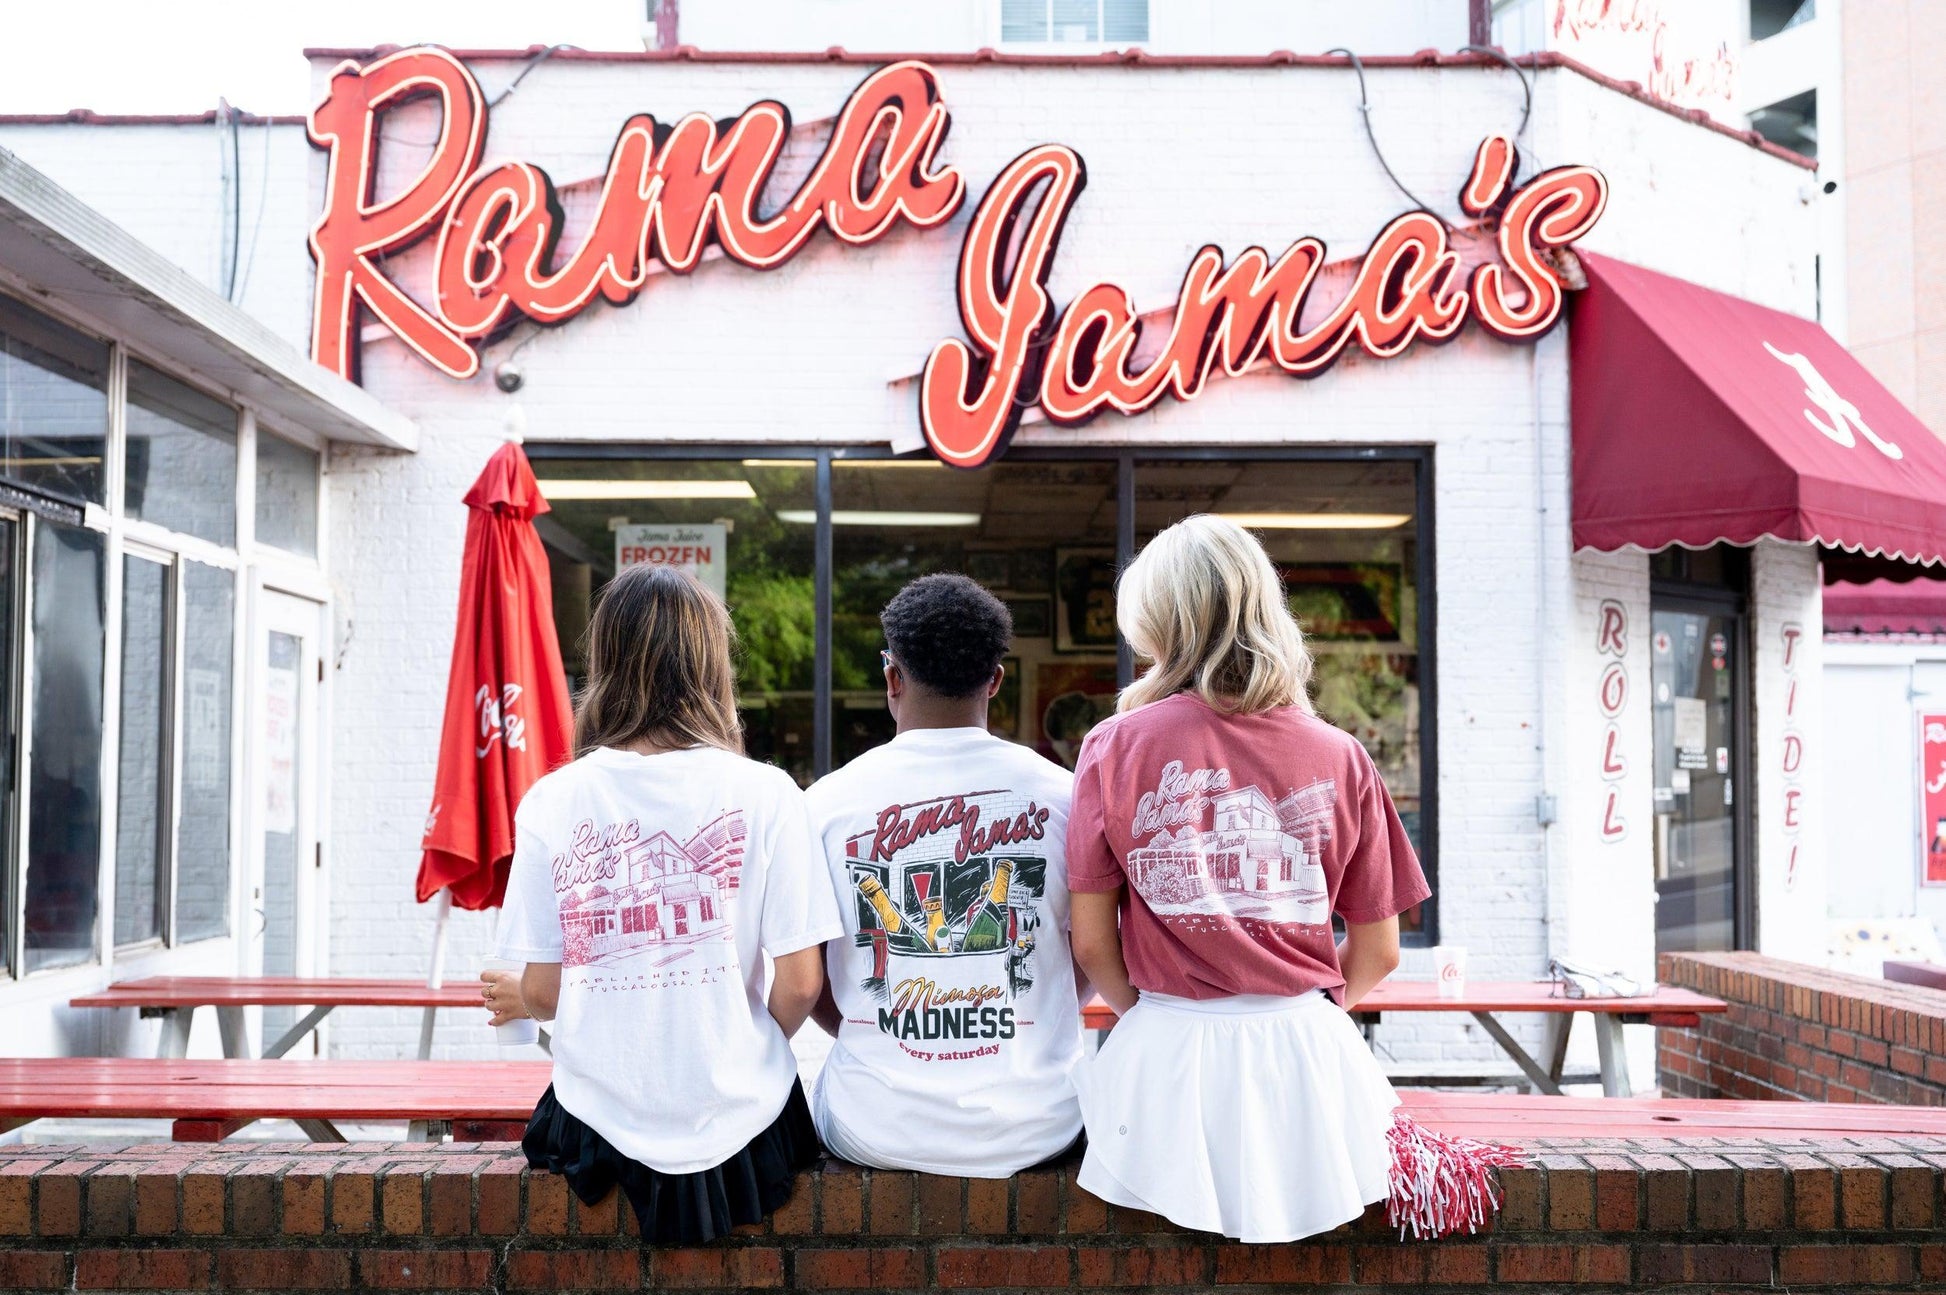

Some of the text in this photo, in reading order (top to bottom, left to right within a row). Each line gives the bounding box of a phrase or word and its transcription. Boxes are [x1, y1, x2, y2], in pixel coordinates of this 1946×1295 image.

[307, 46, 1608, 468] Rama Jama's
[621, 546, 711, 564] FROZEN
[1598, 603, 1630, 838] ROLL
[1783, 628, 1803, 885] TIDE!
[1155, 760, 1230, 808] Rama
[565, 818, 640, 867] Rama
[869, 796, 1049, 866] Rama Jama's
[701, 977, 718, 985] AL
[893, 976, 1006, 1018] Mimosa
[878, 1007, 1016, 1040] MADNESS
[899, 1041, 1001, 1062] every saturday
